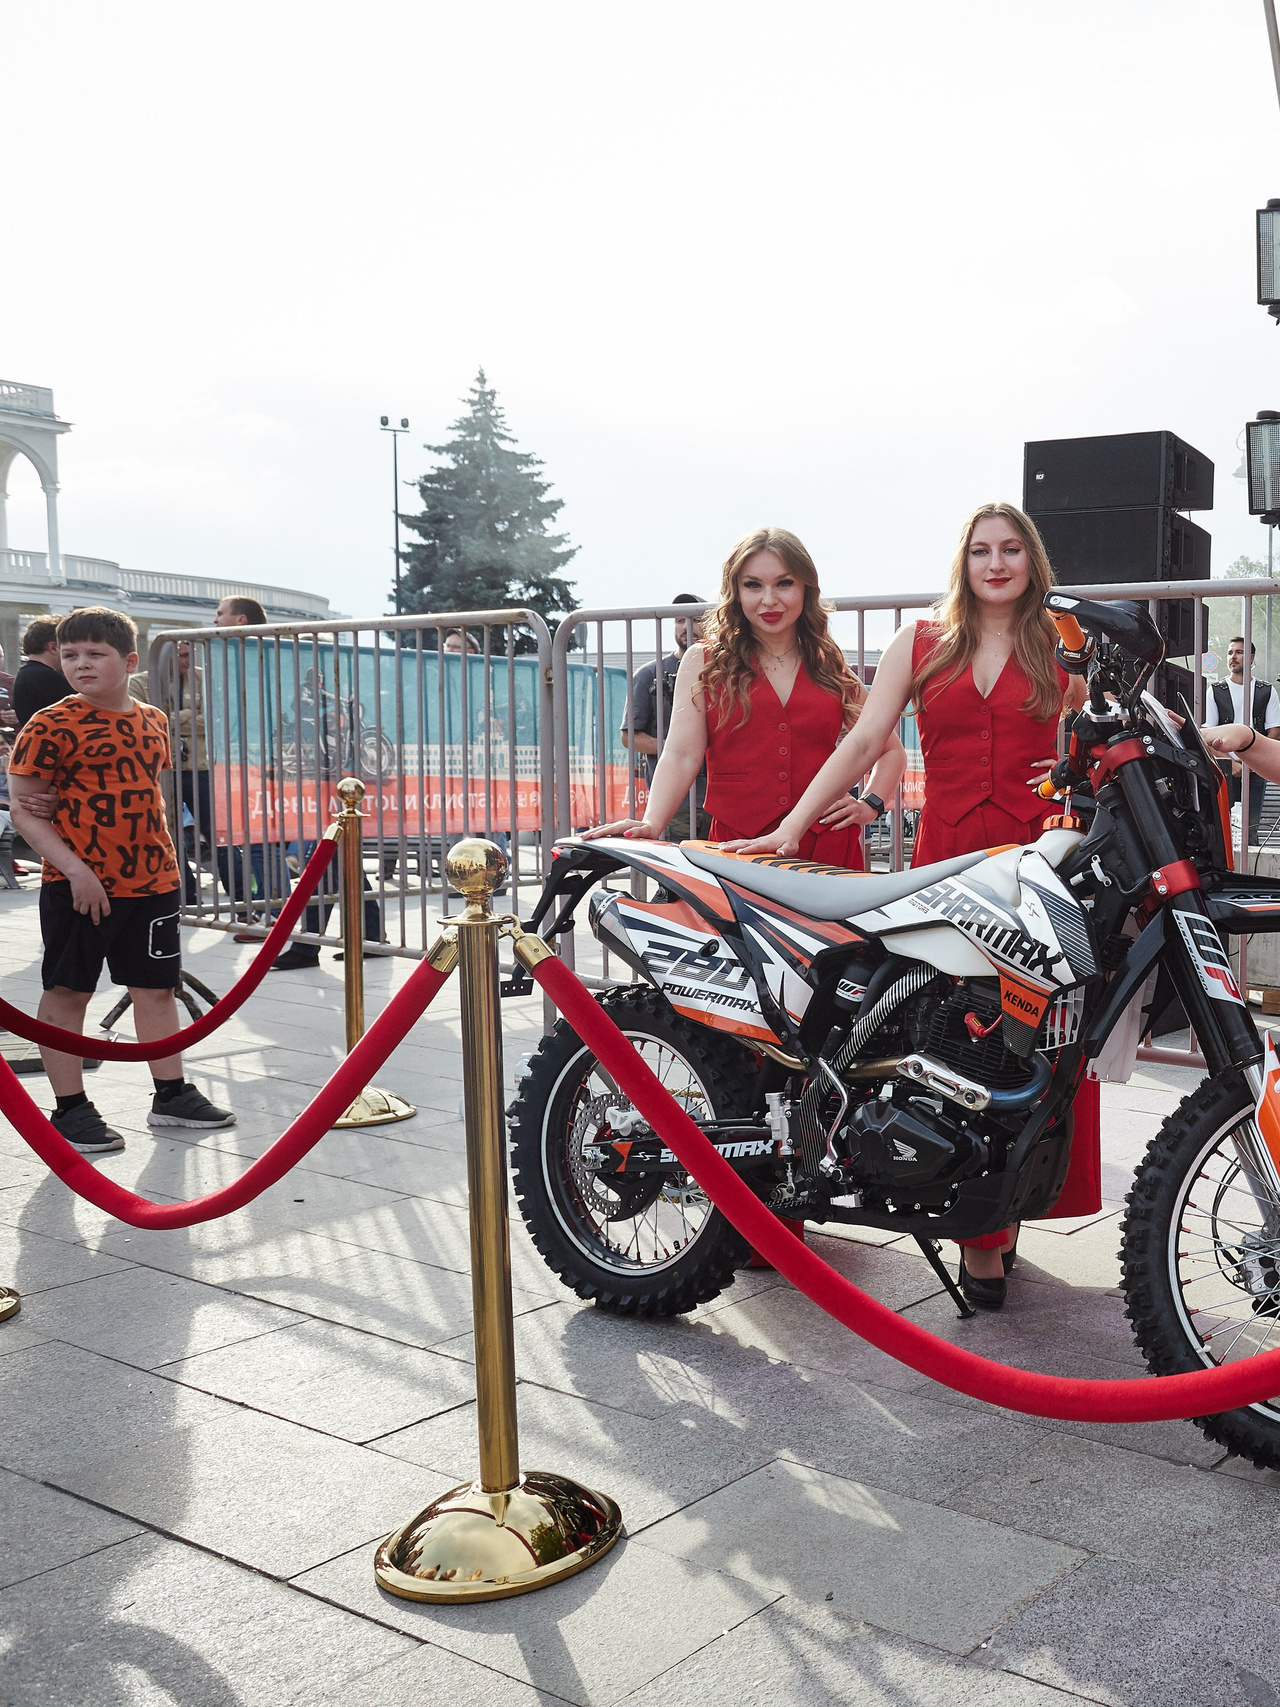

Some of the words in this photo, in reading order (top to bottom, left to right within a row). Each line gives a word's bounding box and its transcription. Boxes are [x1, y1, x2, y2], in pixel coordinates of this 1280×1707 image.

[914, 882, 1065, 987] SHARMAX
[661, 982, 761, 1014] POWERMAX
[1003, 989, 1039, 1018] KENDA
[660, 1140, 775, 1163] SMAX
